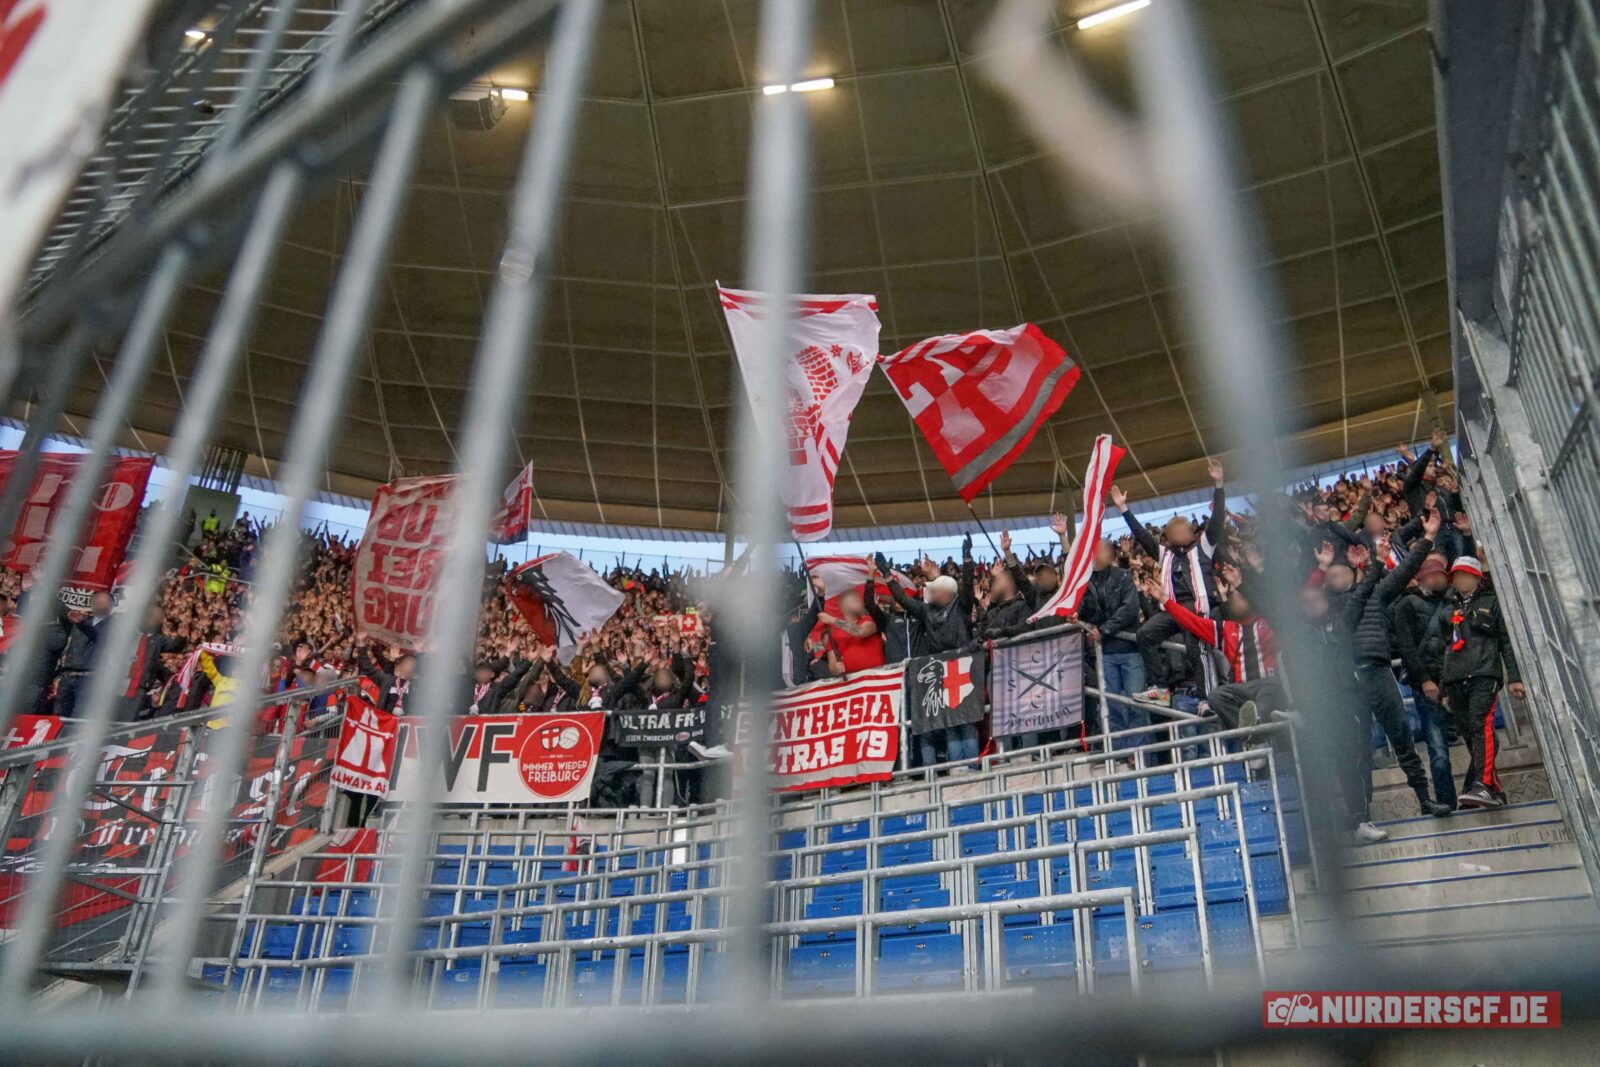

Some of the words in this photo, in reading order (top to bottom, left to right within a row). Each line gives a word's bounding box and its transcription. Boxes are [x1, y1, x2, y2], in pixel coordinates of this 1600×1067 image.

[1004, 706, 1072, 728] Freiburg
[856, 730, 889, 760] 79
[557, 760, 588, 770] WIEDER
[528, 769, 580, 782] FREIBURG
